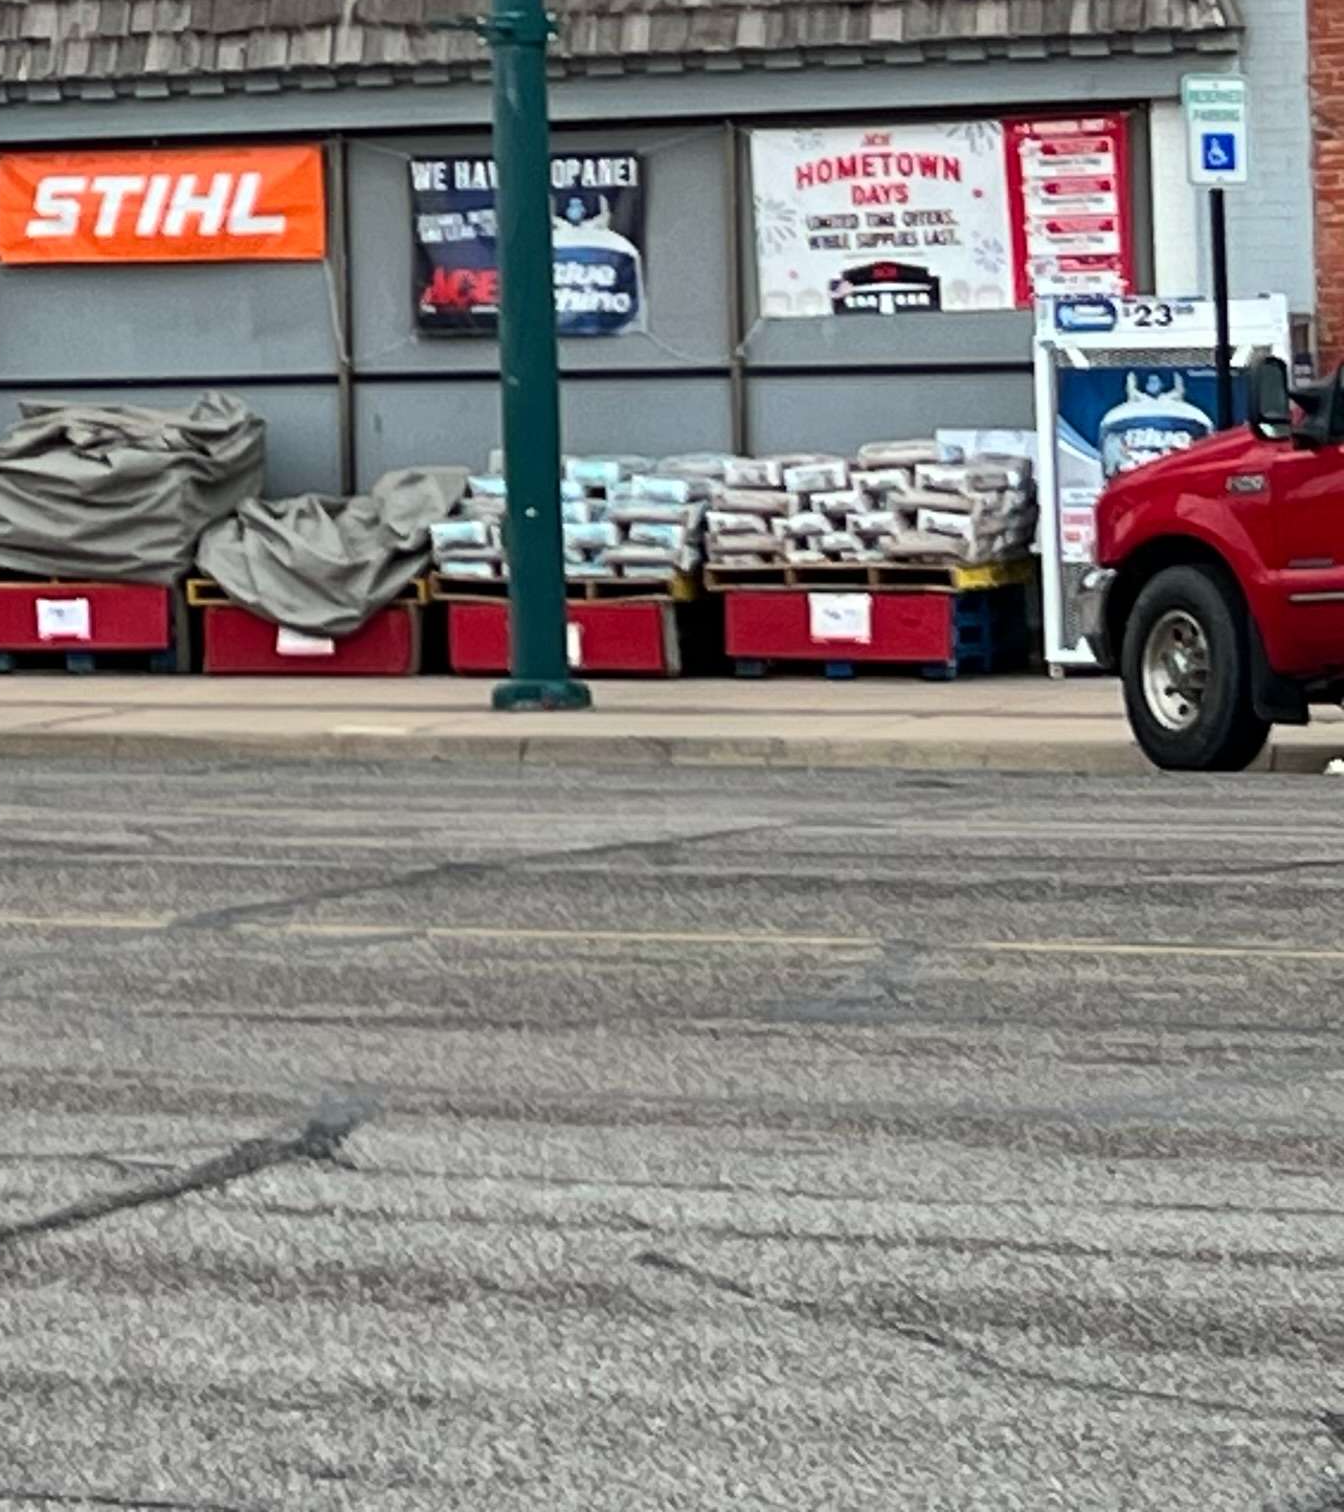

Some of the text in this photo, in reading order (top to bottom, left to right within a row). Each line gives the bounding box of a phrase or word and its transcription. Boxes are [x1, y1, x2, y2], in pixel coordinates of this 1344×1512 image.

[413, 161, 448, 191] WE
[796, 151, 962, 189] HOMETOWN
[26, 173, 286, 238] STIHL
[852, 183, 909, 205] DAYS
[420, 267, 501, 306] ACE
